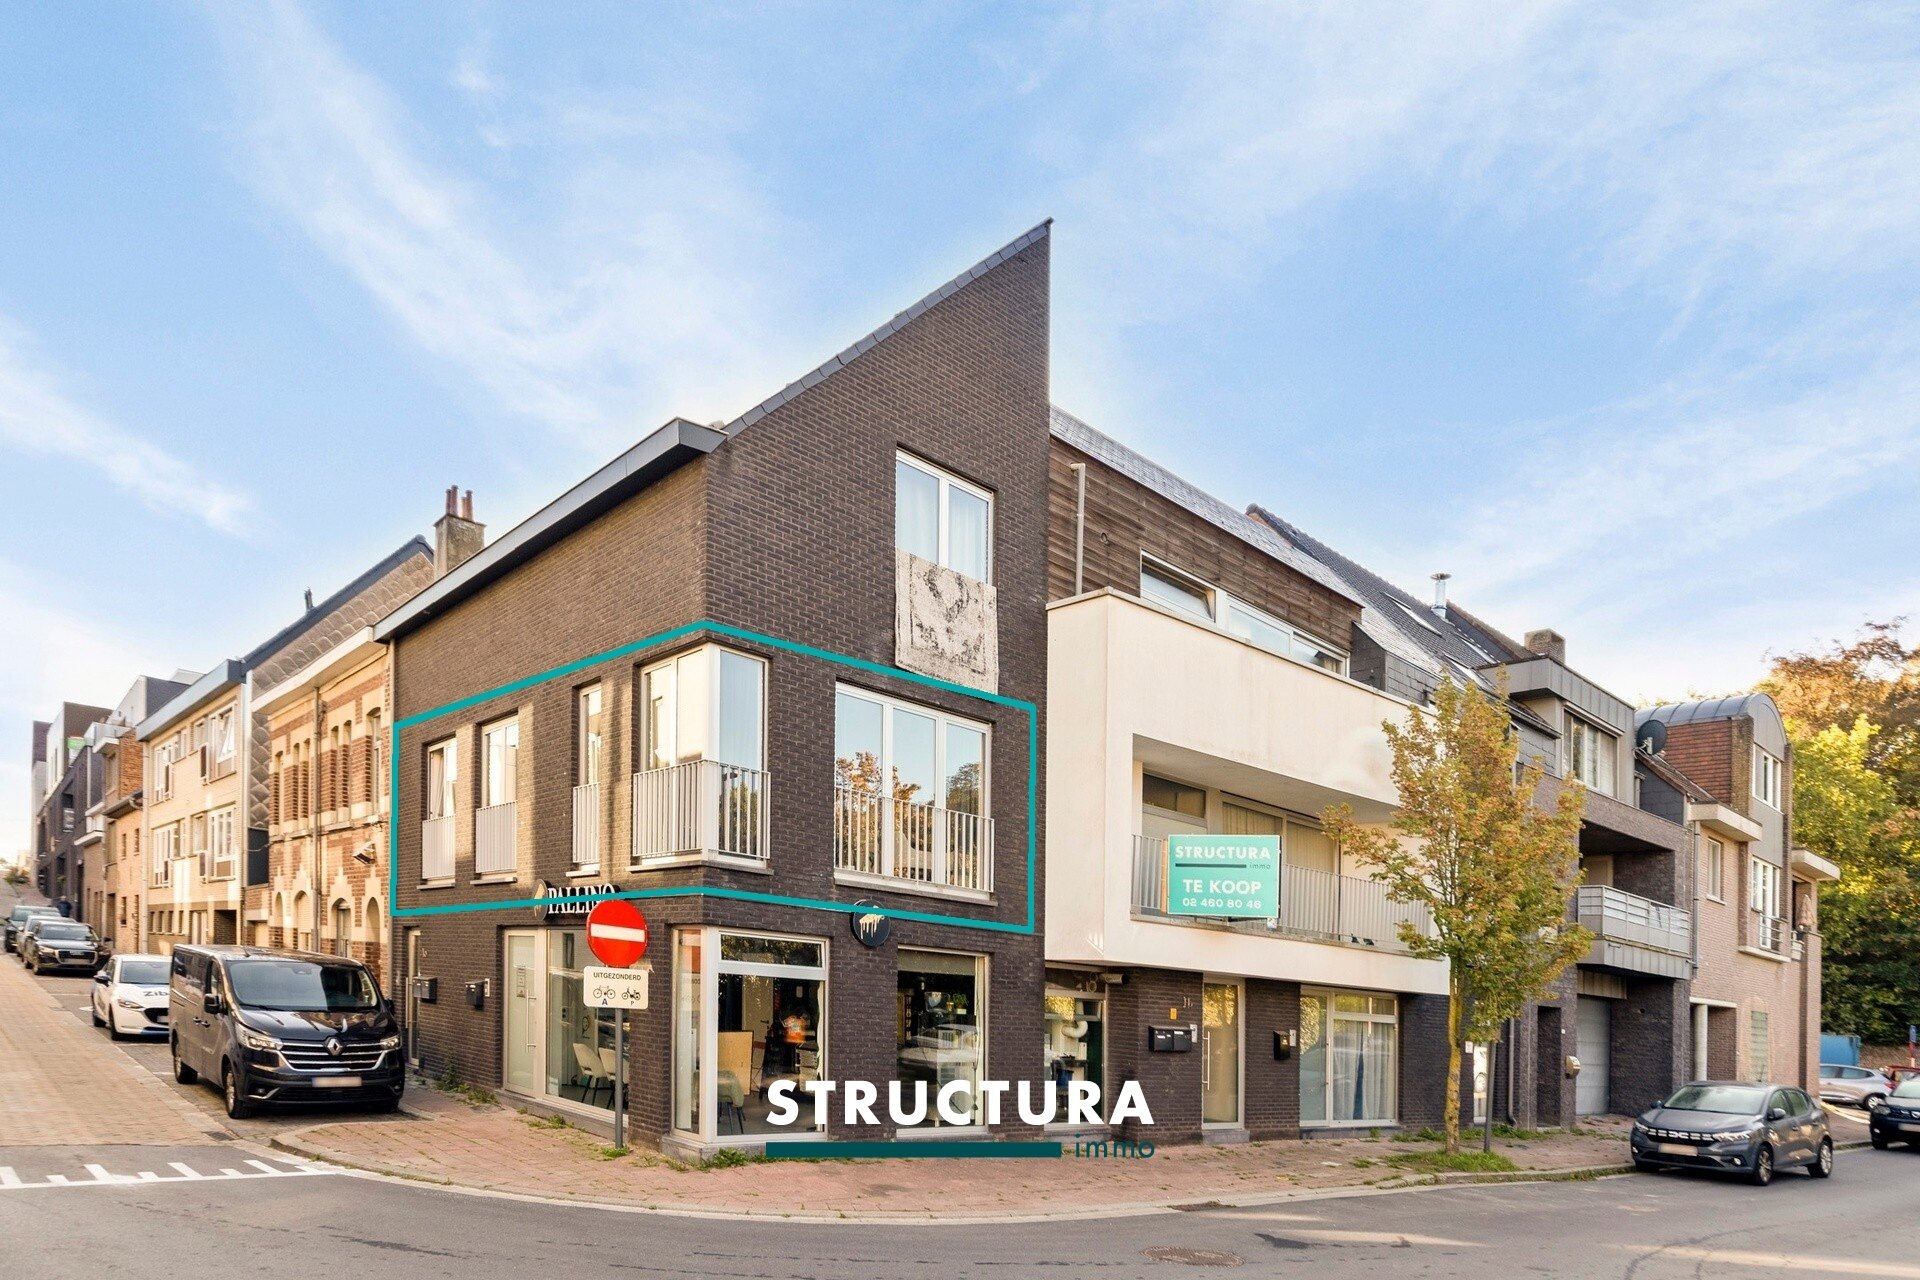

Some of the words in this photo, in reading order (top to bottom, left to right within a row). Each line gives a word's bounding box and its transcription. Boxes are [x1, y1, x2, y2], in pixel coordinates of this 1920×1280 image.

[1174, 845, 1272, 860] STRUCTURA
[1249, 861, 1272, 870] immo
[1182, 879, 1204, 894] TE
[1209, 879, 1263, 895] KOOP
[1182, 897, 1198, 908] 02
[1200, 898, 1224, 908] 460
[1227, 899, 1244, 909] 80
[1245, 899, 1263, 910] 46
[593, 971, 642, 981] UITGEZONDERD
[601, 997, 608, 1006] A
